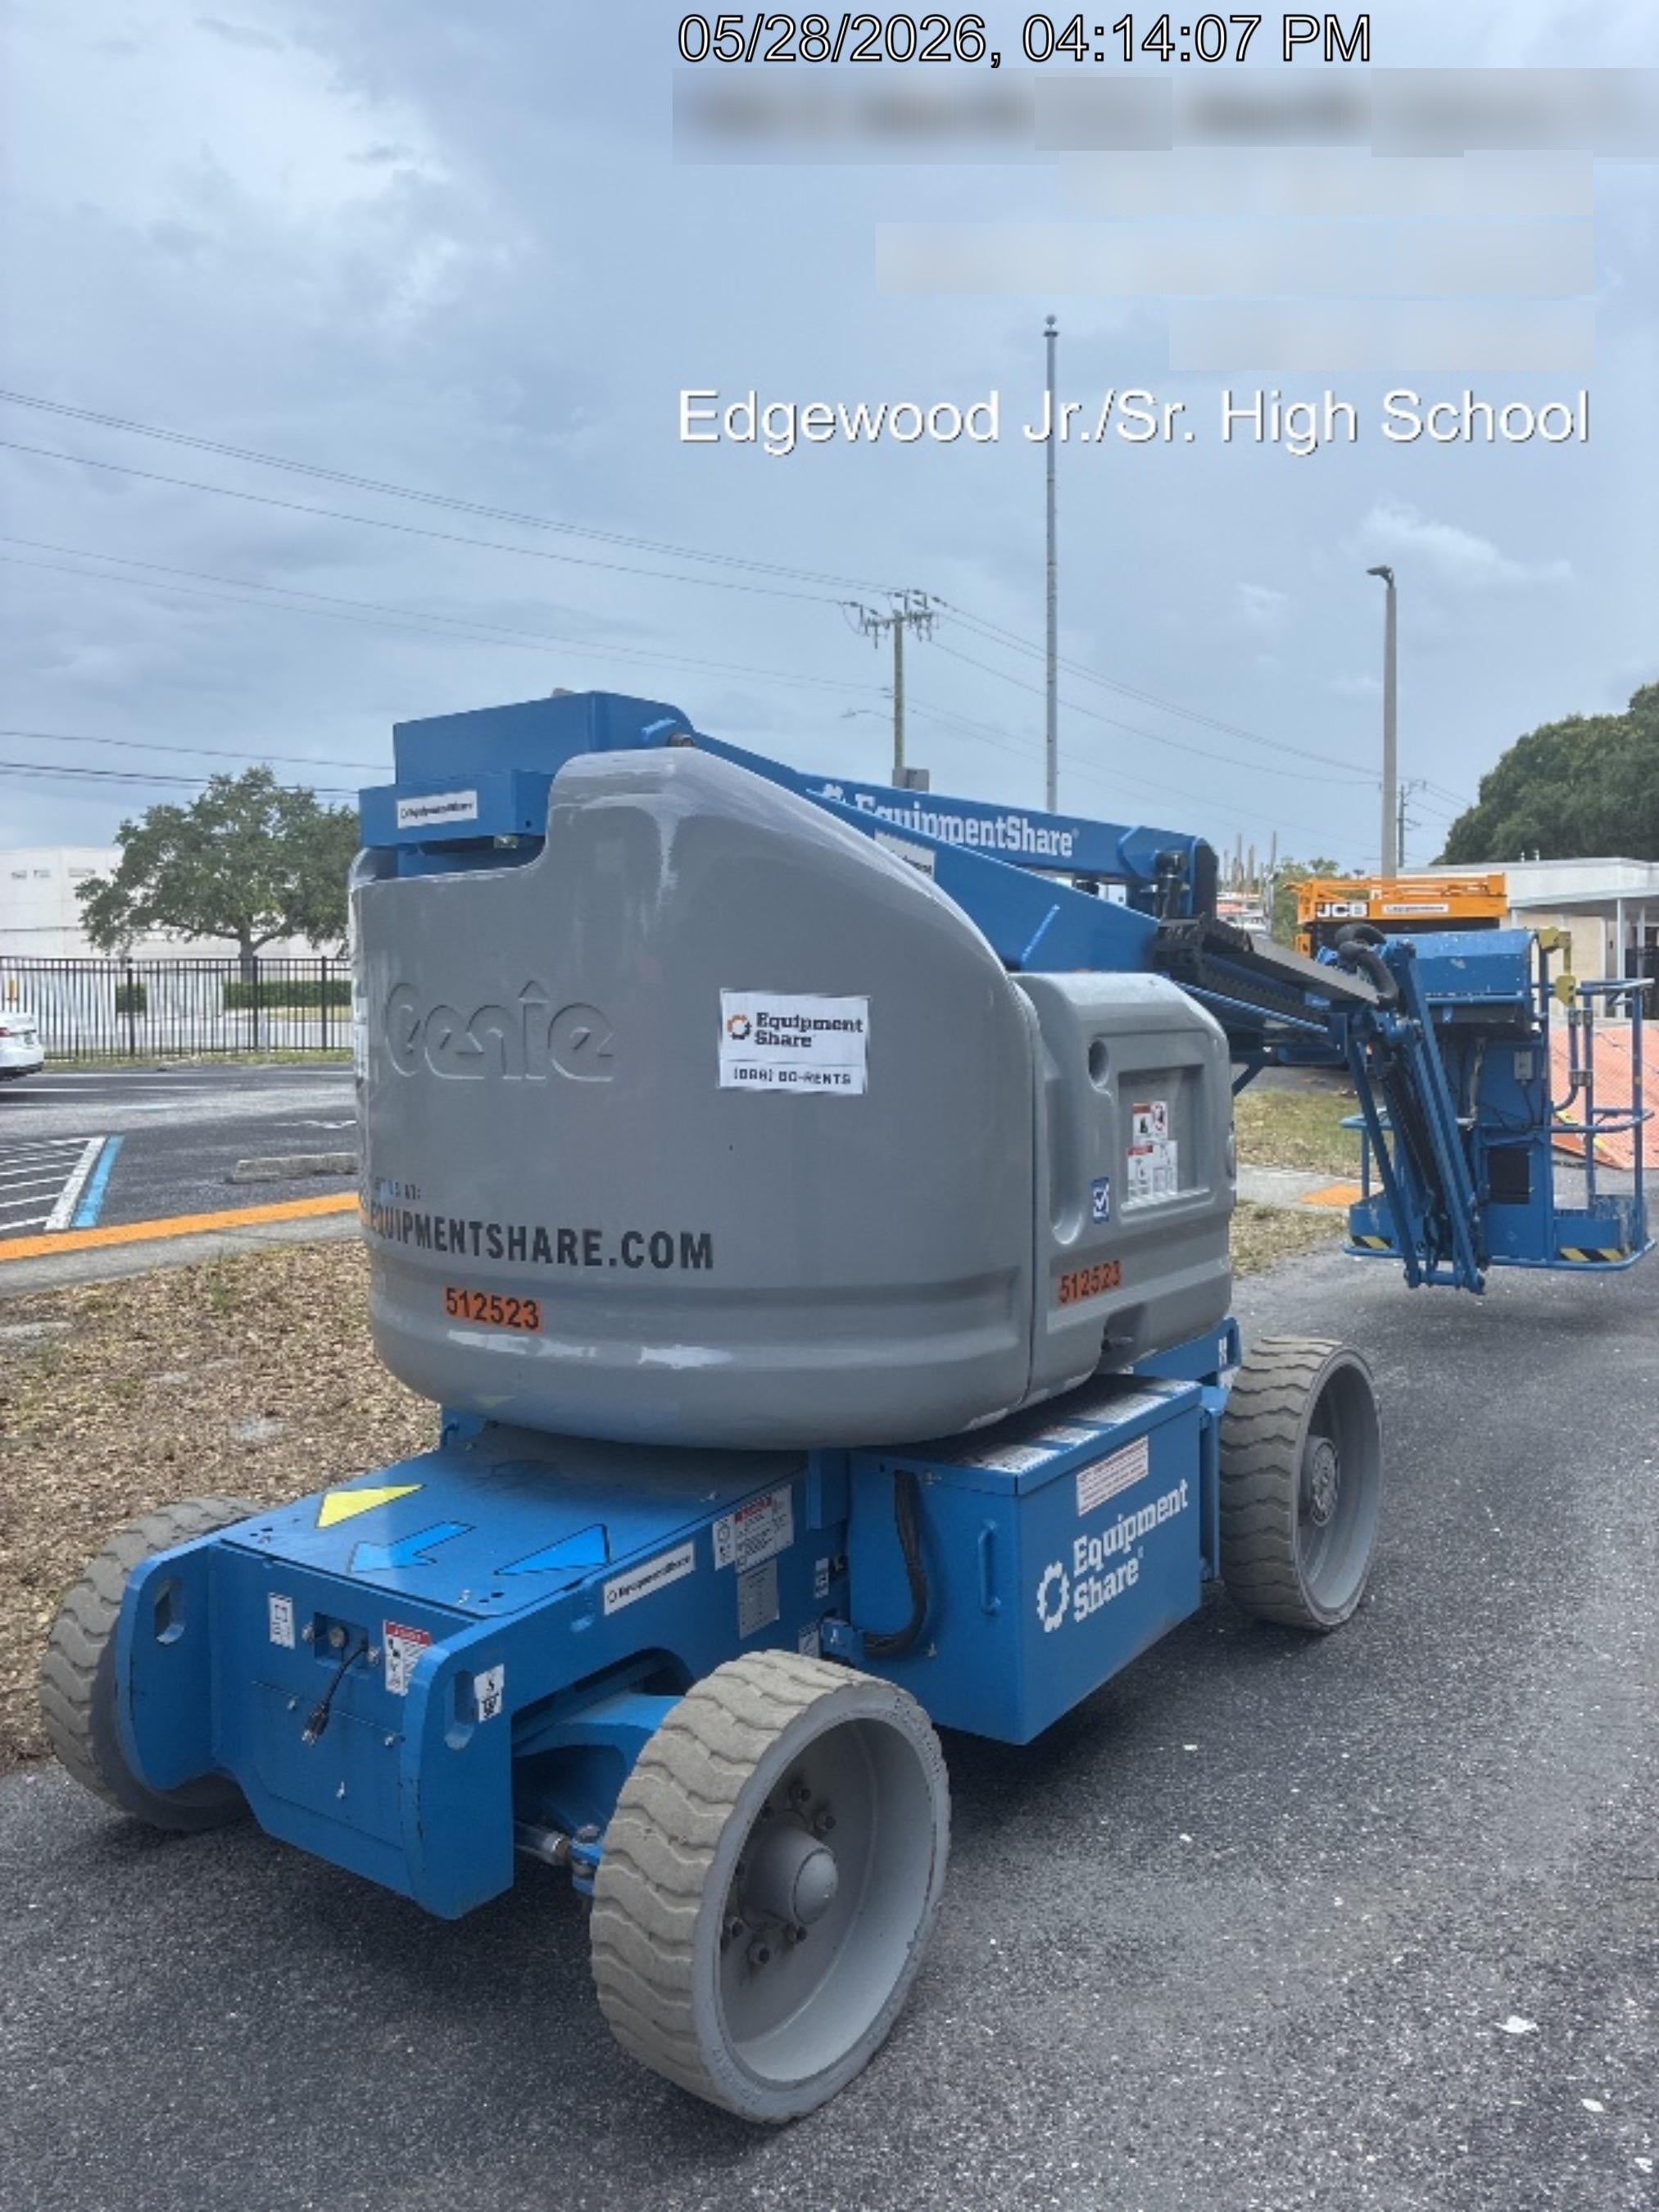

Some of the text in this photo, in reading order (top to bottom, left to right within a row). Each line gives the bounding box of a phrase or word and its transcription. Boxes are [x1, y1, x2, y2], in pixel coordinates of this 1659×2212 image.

[385, 980, 614, 1082] Genie
[755, 1012, 863, 1033] Equipment
[755, 1029, 813, 1048] Share
[1058, 1262, 1122, 1303] 512523
[445, 1287, 540, 1330] 512523
[1072, 1478, 1189, 1576] Equipment
[1072, 1557, 1140, 1623] Share
